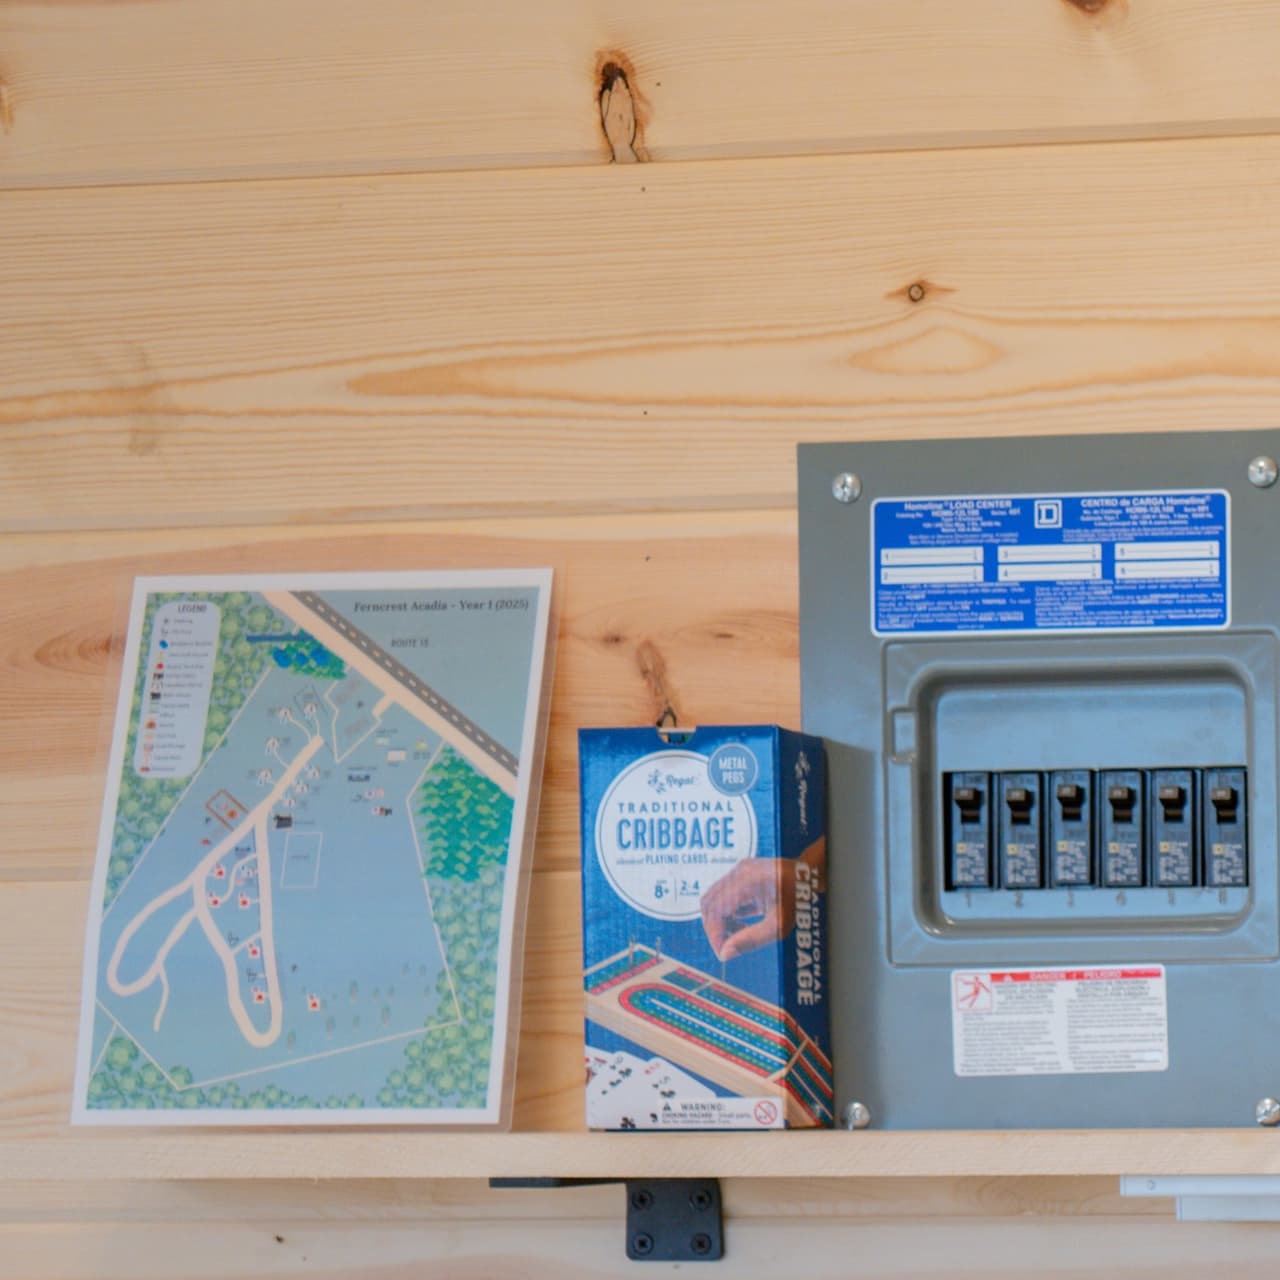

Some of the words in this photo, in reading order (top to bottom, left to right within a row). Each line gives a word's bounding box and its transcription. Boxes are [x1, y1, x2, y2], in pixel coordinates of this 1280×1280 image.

[950, 501, 974, 509] LOAD
[976, 500, 1012, 508] CENTER
[1081, 498, 1118, 507] CENTRO
[1132, 497, 1166, 506] CARGA
[177, 604, 208, 614] LEGEND
[354, 602, 407, 613] Ferncrest
[411, 600, 447, 612] Acadia
[459, 600, 483, 611] Year
[495, 599, 529, 612] (2025)
[719, 757, 747, 770] METAL
[665, 774, 694, 788] Regal
[722, 771, 745, 785] PEGS
[618, 801, 734, 814] TRADITIONAL
[617, 817, 735, 850] CRIBBAGE
[645, 854, 680, 865] PLAYING
[681, 854, 709, 865] CARDS
[654, 884, 669, 899] 8+
[795, 862, 815, 1006] CRIBBAGE
[811, 867, 822, 1003] TRADITIONAL
